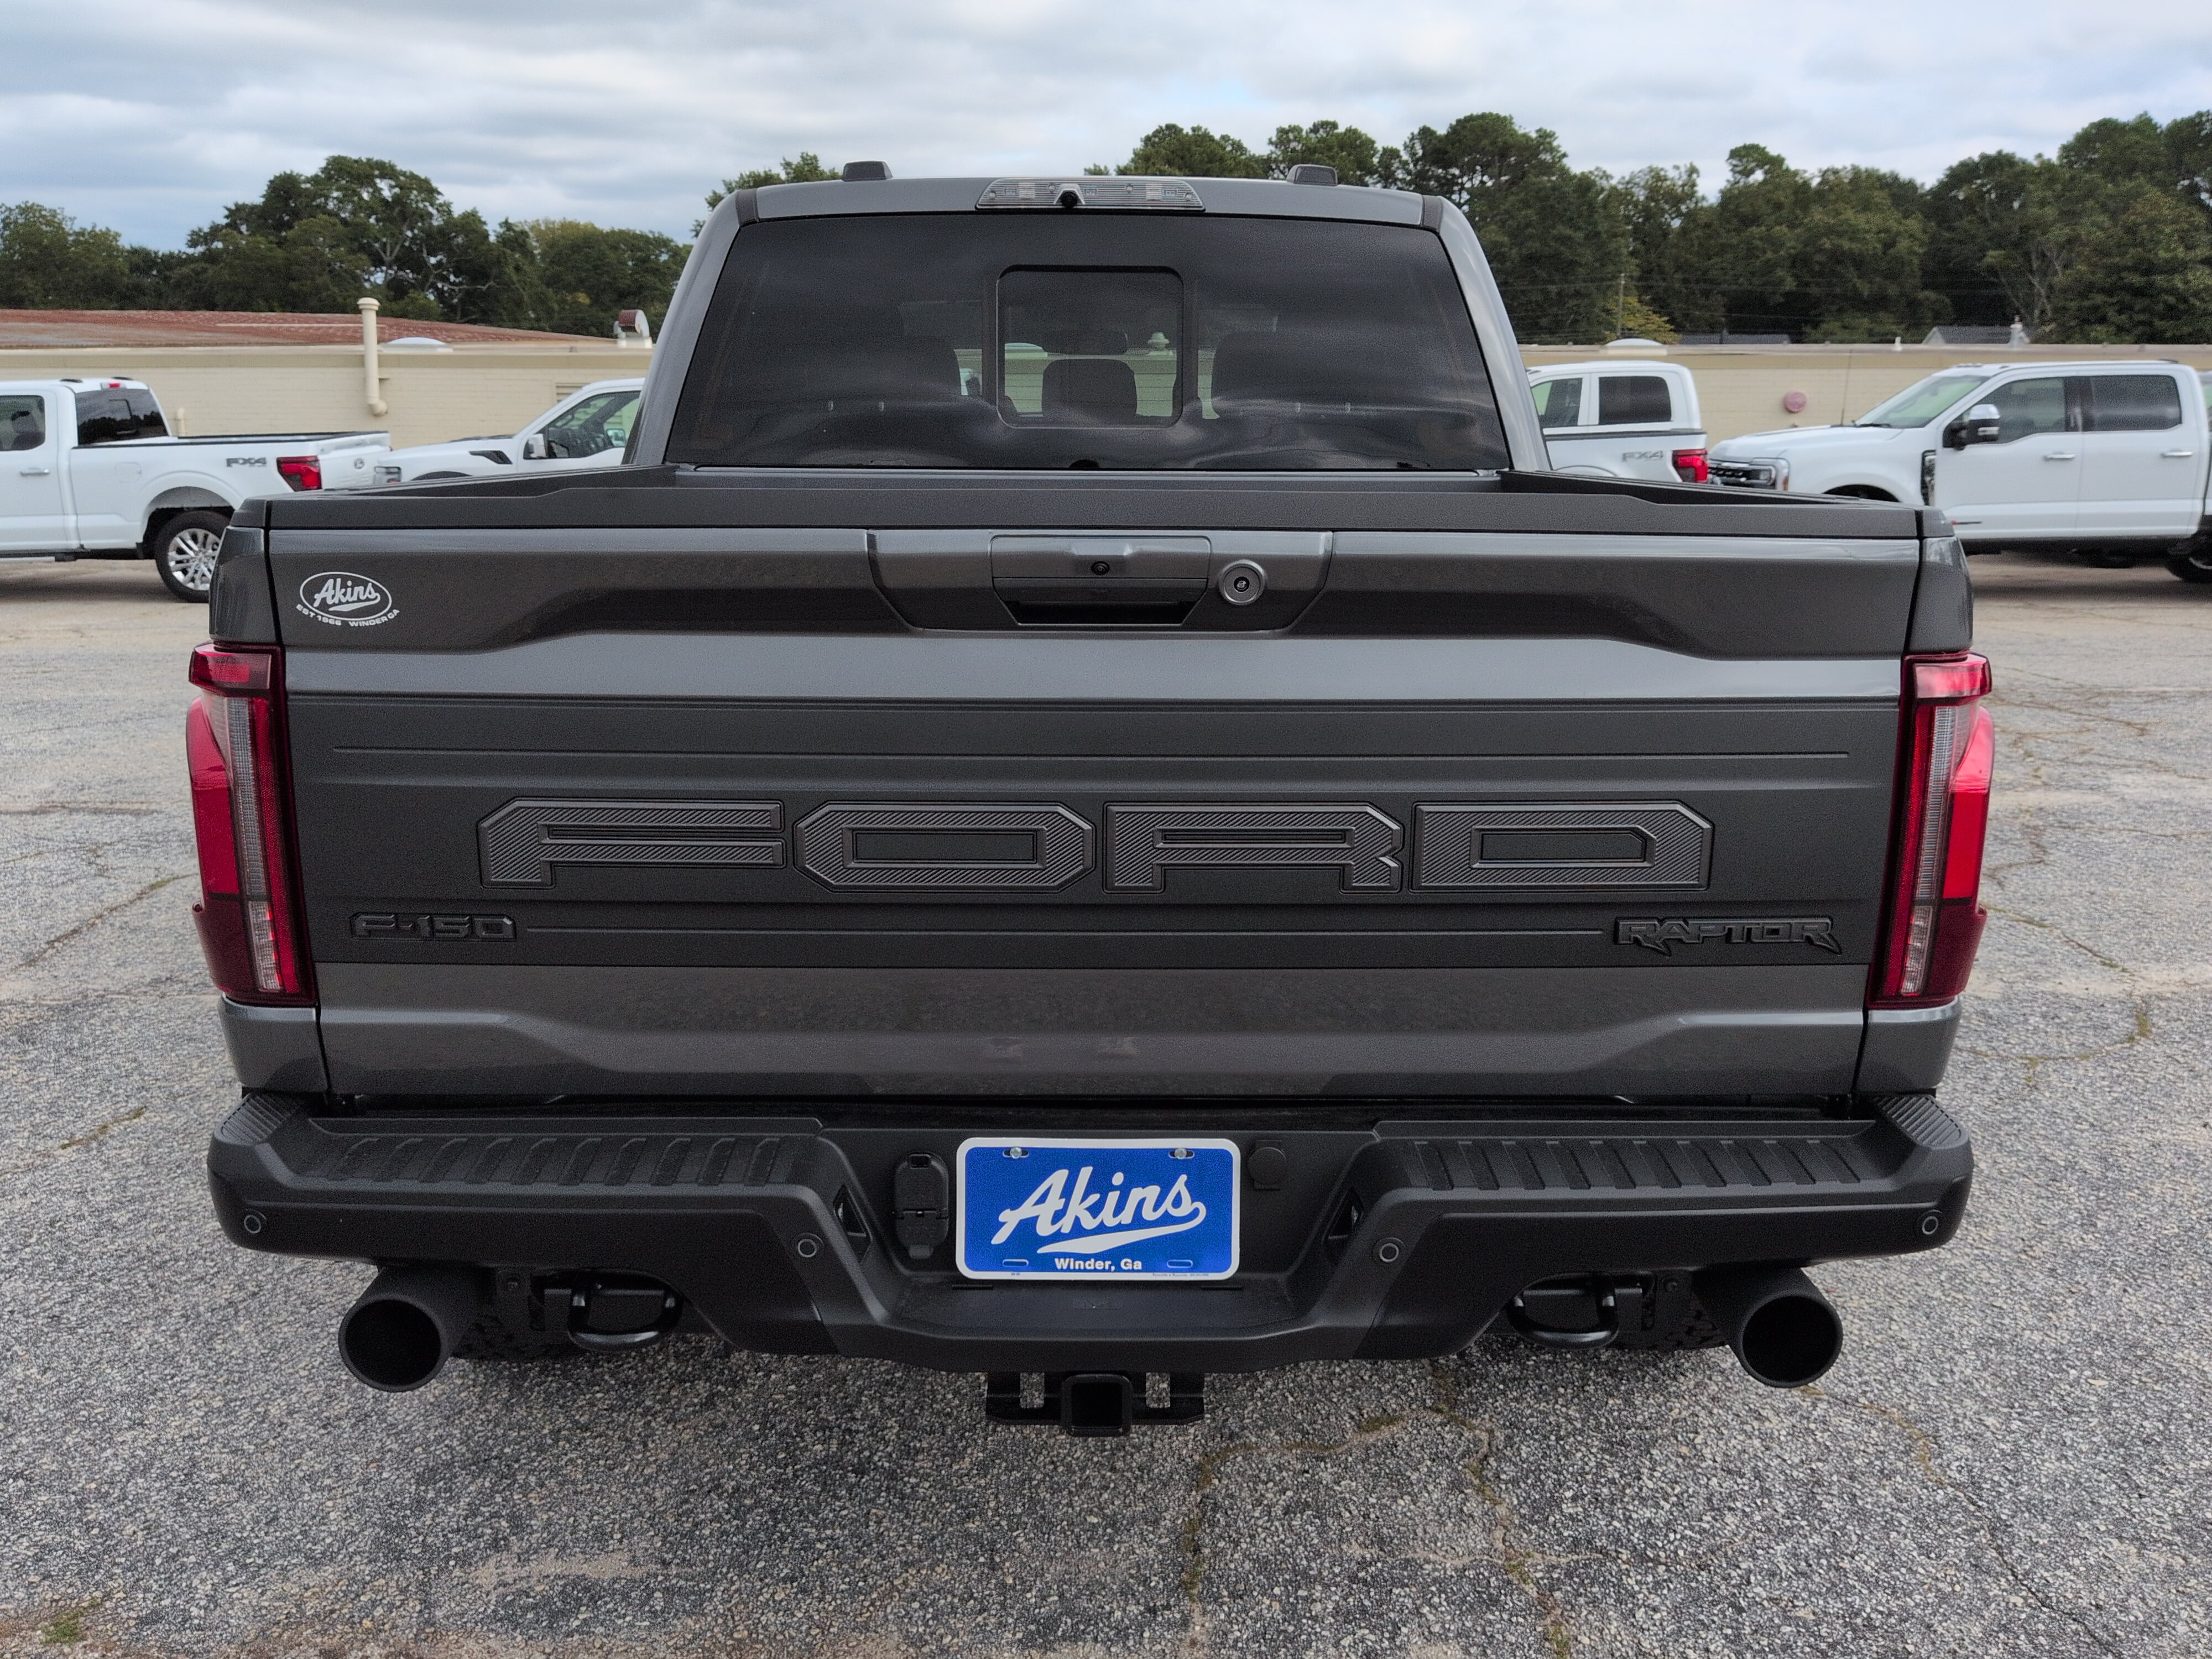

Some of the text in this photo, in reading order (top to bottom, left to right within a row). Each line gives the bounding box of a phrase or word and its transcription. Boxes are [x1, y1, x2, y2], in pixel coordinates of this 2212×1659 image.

[1622, 451, 1663, 462] FX4
[313, 578, 380, 612] Akins
[296, 603, 316, 618] EST
[348, 615, 389, 627] WINDER
[387, 609, 400, 619] GA
[477, 798, 1714, 892] FORD
[351, 913, 516, 941] F-150
[1614, 917, 1843, 957] RAPTOR
[990, 1166, 1207, 1254] Akins
[1054, 1258, 1142, 1272] Winder, Ga
